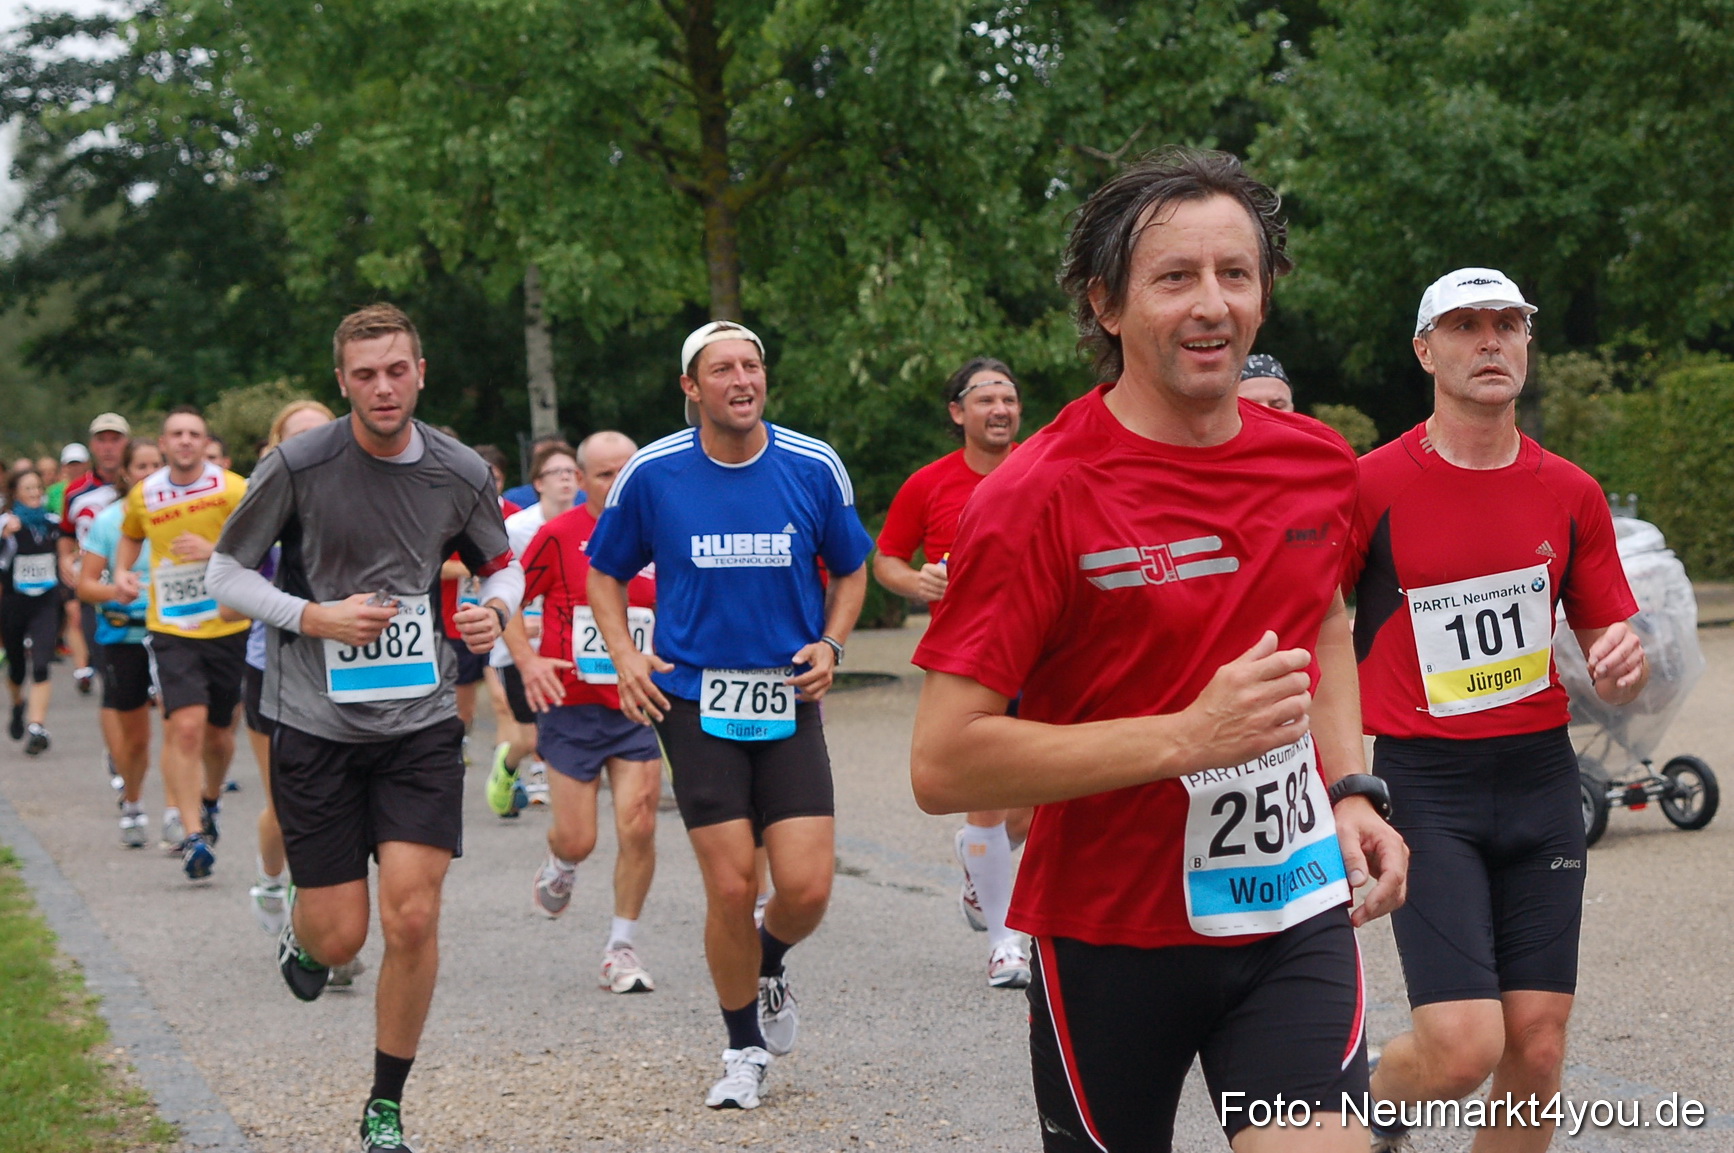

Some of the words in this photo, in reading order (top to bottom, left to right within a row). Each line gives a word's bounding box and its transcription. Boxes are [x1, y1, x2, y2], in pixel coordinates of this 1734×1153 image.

[691, 533, 792, 556] HUBER
[714, 556, 787, 565] TECHNOLOGY
[1413, 596, 1461, 613] PARTL
[1463, 584, 1526, 606] Neumarkt
[1445, 602, 1525, 661] 101
[1426, 664, 1433, 673] B
[1466, 667, 1522, 693] Jürgen
[709, 678, 787, 715] 2765
[726, 723, 769, 738] Günter
[1209, 761, 1316, 859] 2583
[1193, 857, 1202, 869] B
